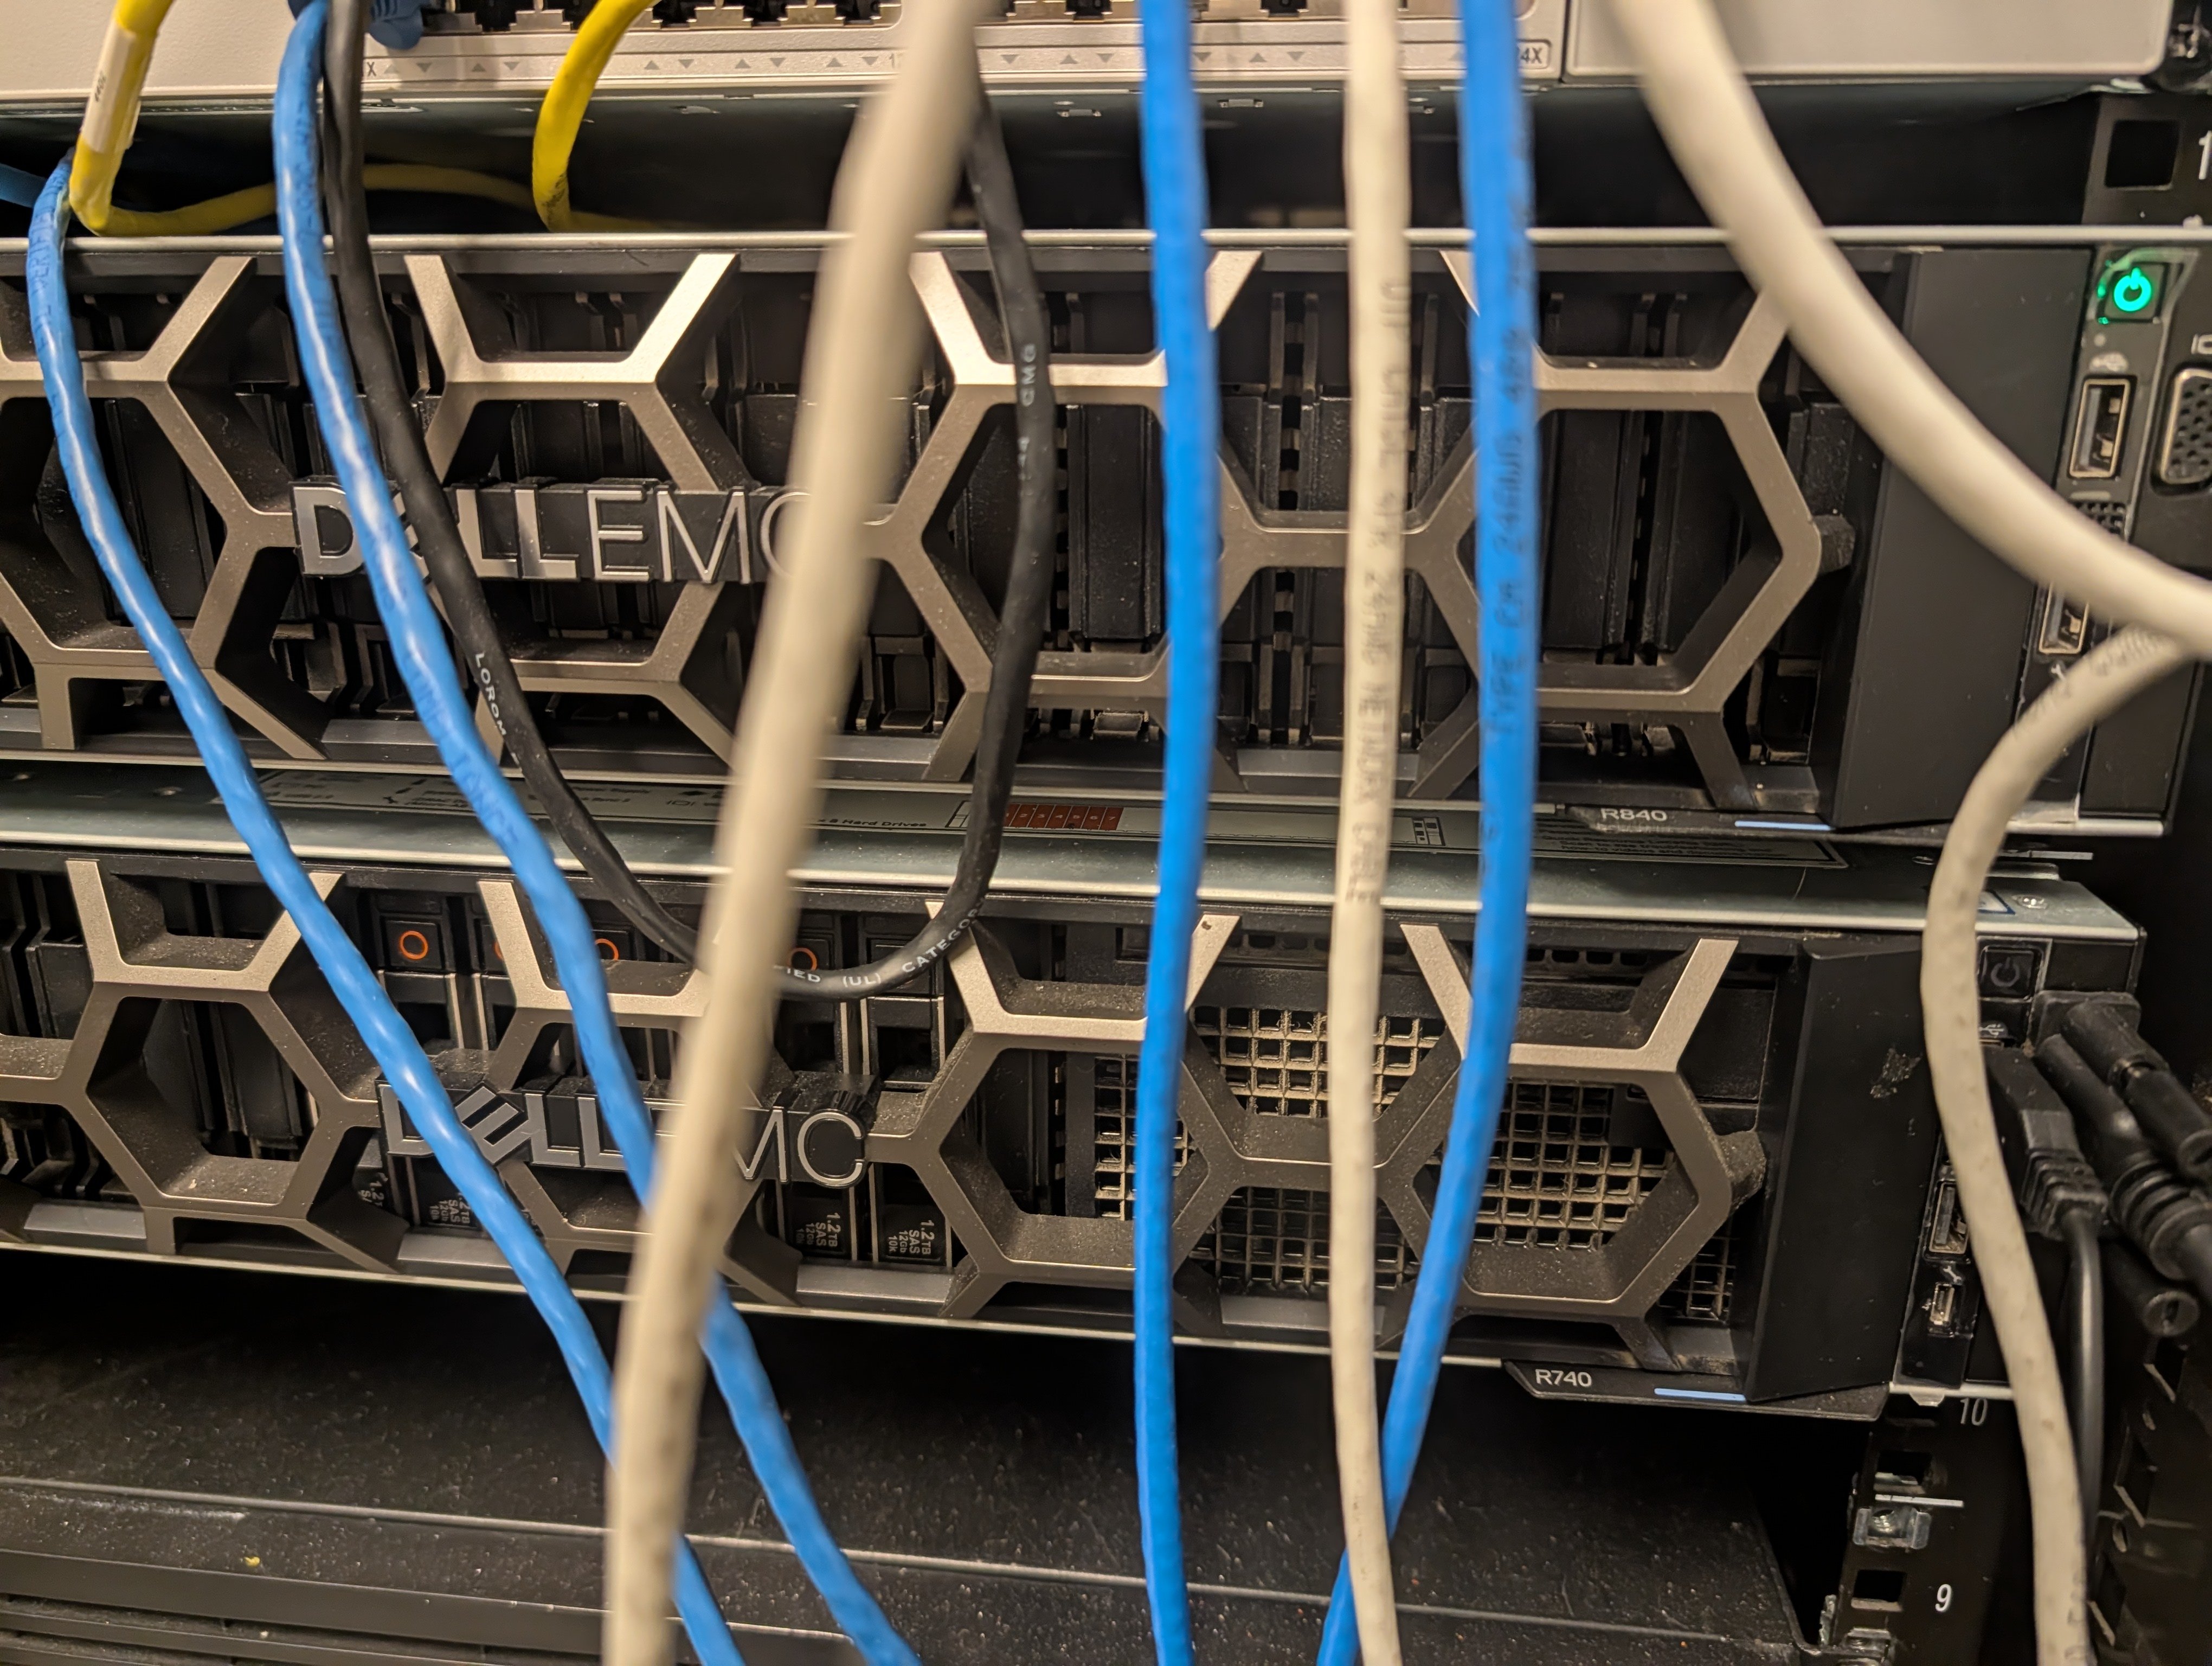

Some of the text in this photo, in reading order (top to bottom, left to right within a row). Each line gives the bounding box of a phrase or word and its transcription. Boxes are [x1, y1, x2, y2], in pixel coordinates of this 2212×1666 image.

[1602, 806, 1667, 824] R840
[842, 972, 882, 987] (UL)
[806, 1223, 814, 1246] 12Gb
[815, 1222, 827, 1246] SAS
[826, 1212, 841, 1247] 1.2TB
[920, 1220, 935, 1255] 1.2TB
[888, 1235, 897, 1252] 10k
[899, 1230, 908, 1253] 12Gb
[909, 1229, 920, 1254] SAS
[1535, 1369, 1592, 1388] R740
[1959, 1396, 1989, 1426] 10
[1934, 1583, 1953, 1613] 9
